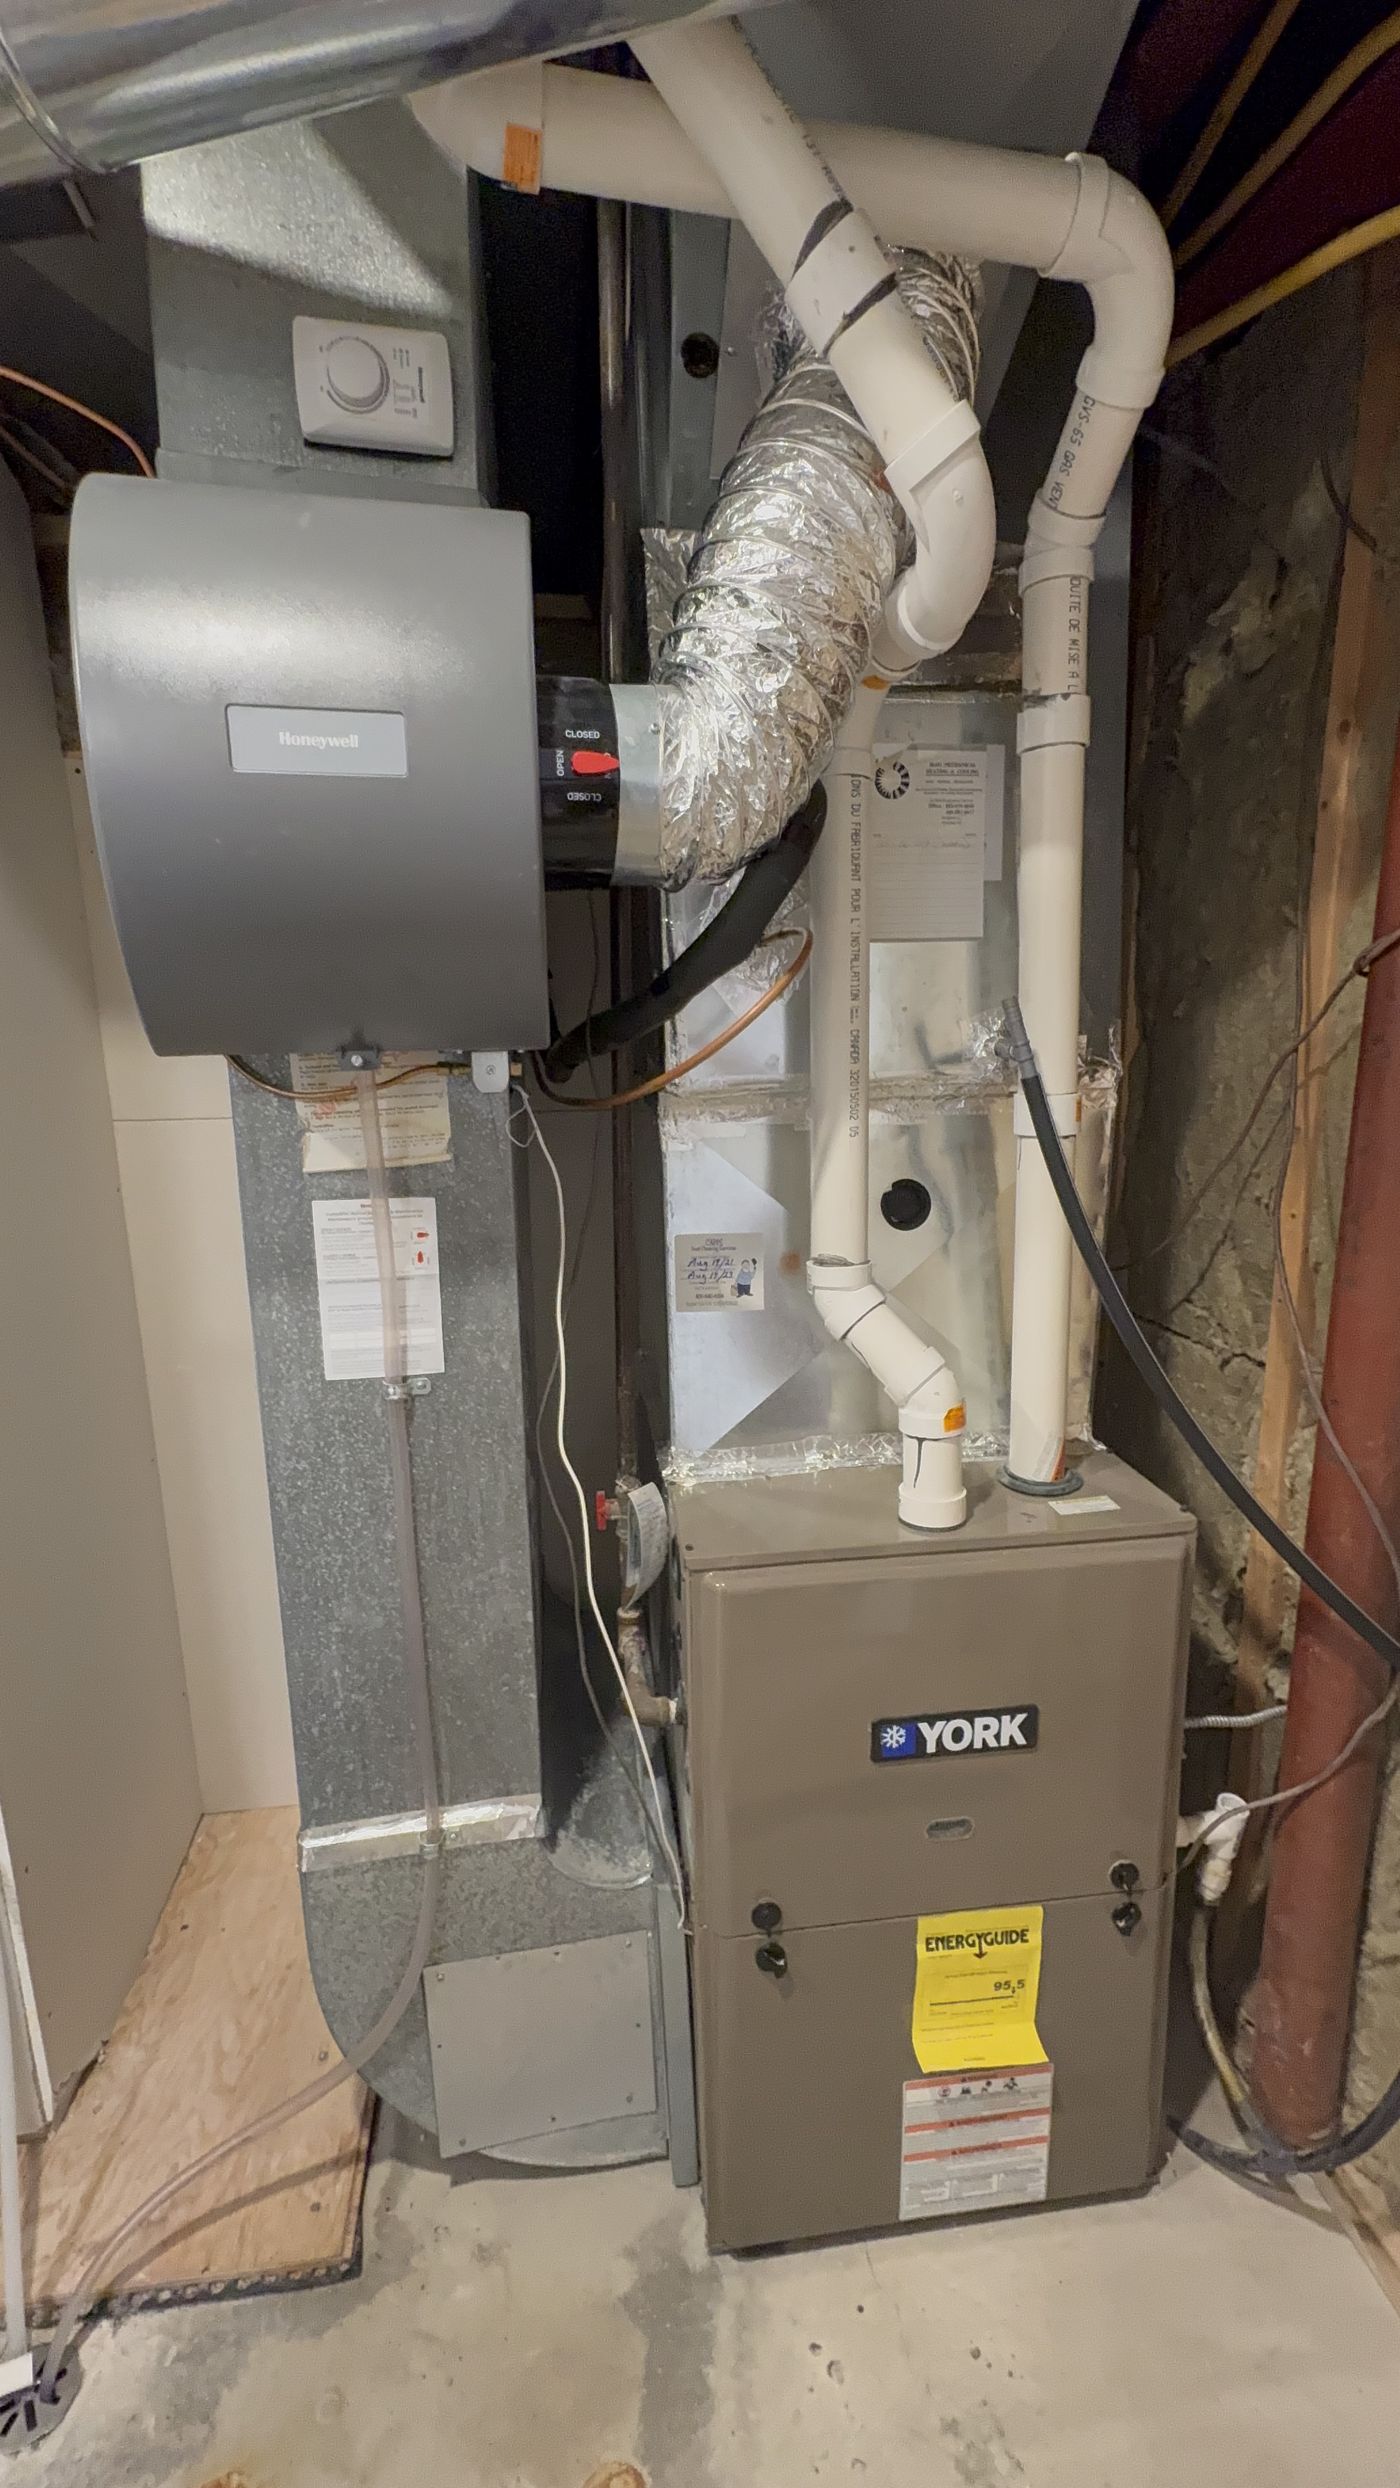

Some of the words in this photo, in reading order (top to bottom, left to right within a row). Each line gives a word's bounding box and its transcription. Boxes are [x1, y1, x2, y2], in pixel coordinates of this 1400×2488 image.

[1070, 395, 1096, 447] GVS-65
[1060, 450, 1076, 477] GAS
[1068, 618, 1081, 633] DE
[1068, 638, 1080, 665] MISE
[278, 731, 359, 750] Honeywell
[565, 729, 601, 739] CLOSED
[556, 749, 565, 777] OPEN
[567, 792, 602, 802] CLOSED
[850, 804, 861, 818] DU
[850, 888, 861, 913] POUR
[687, 1257, 709, 1272] Aug
[687, 1270, 707, 1285] Aug
[917, 1712, 1029, 1754] YORK
[925, 1928, 1030, 1953] ENERGYGUIDE
